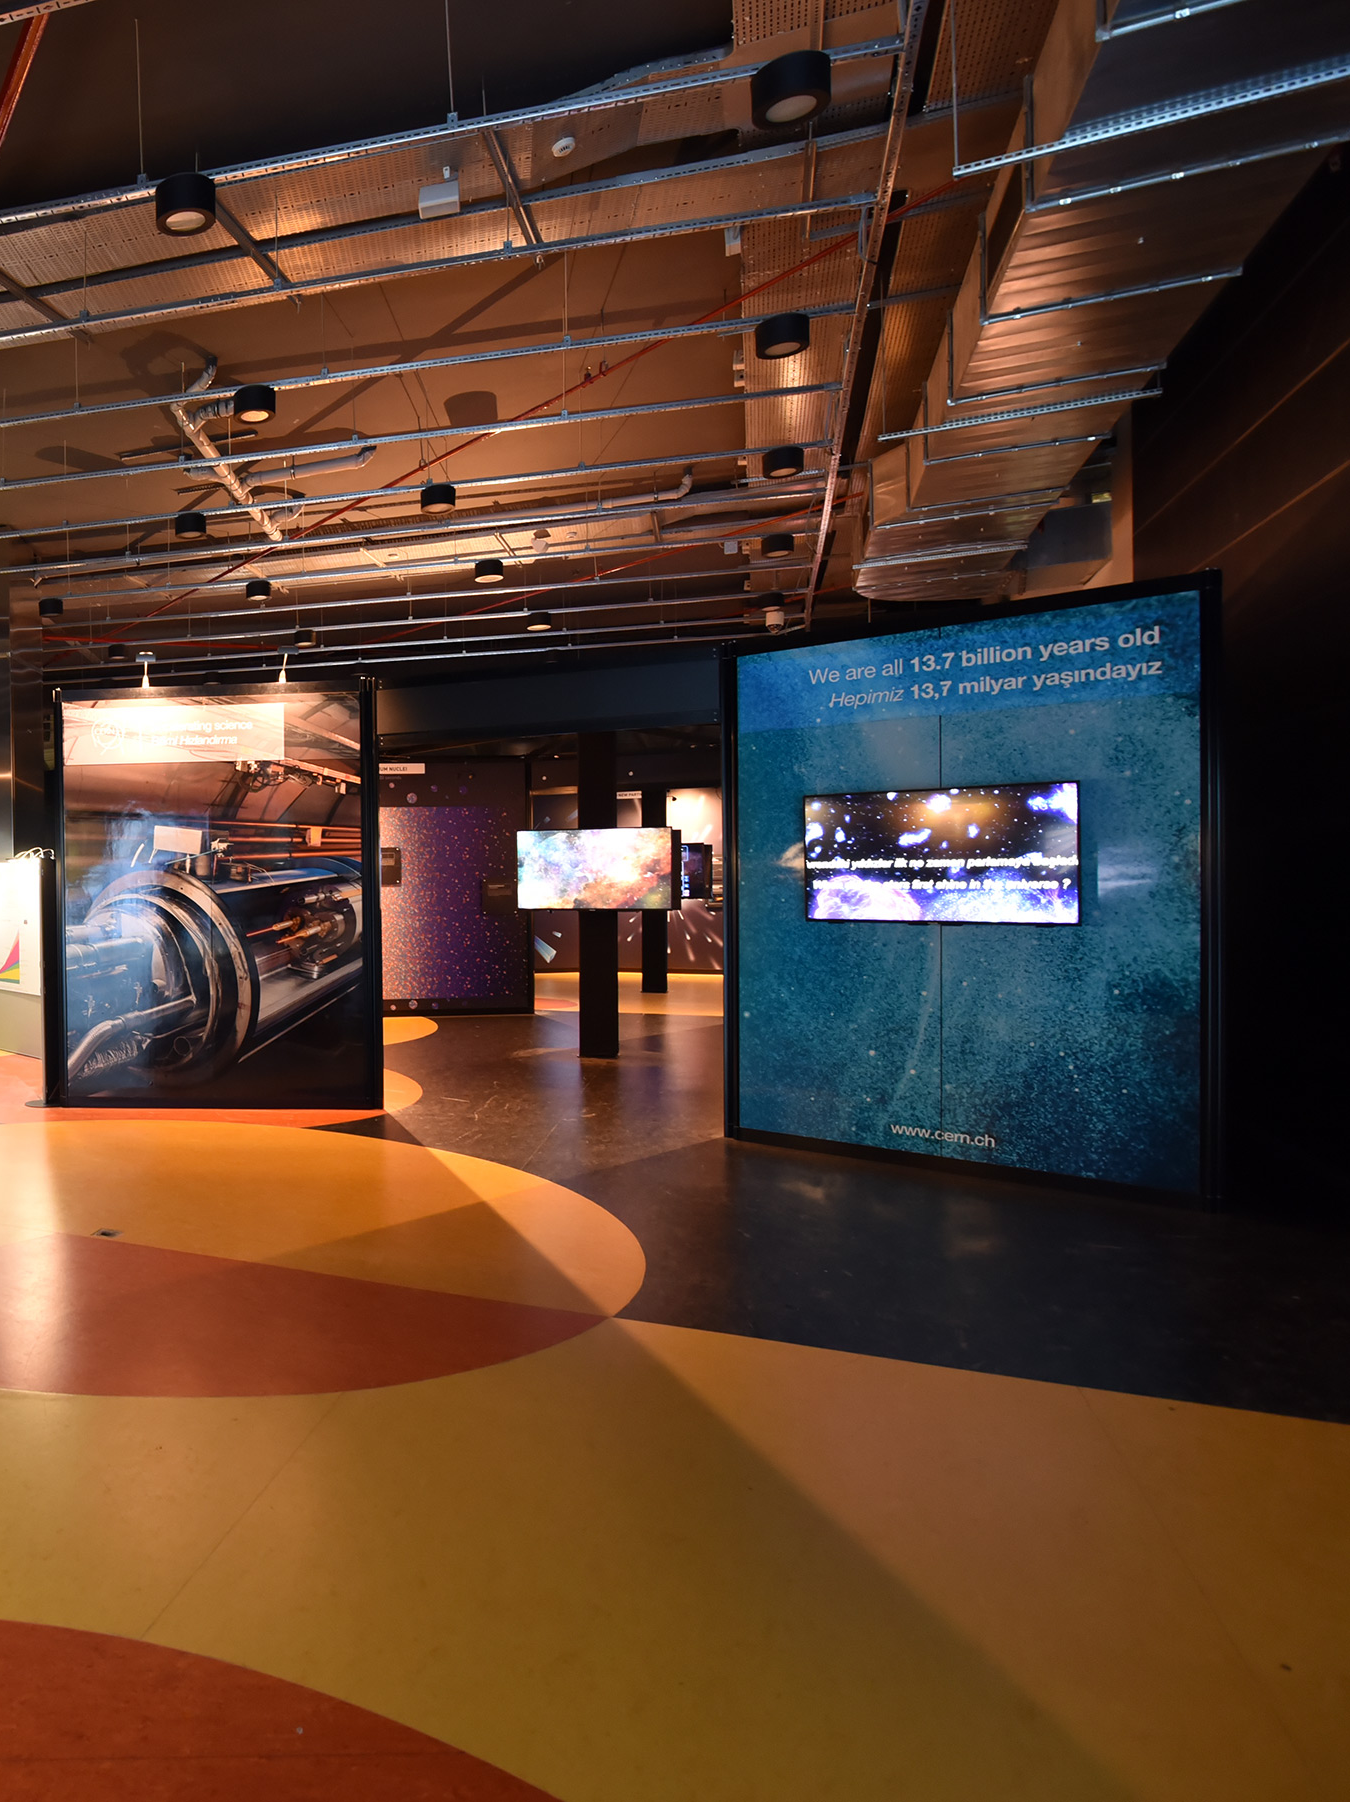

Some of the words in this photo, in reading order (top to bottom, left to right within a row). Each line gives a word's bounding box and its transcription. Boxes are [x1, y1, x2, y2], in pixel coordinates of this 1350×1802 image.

[808, 667, 840, 685] We
[845, 665, 876, 681] are
[881, 658, 903, 677] all
[910, 652, 955, 672] 13.7
[961, 646, 1032, 667] billion
[1039, 636, 1110, 662] years
[1118, 625, 1161, 648] old
[829, 687, 905, 709] Hepimiz
[910, 680, 953, 700] 13,7
[958, 675, 1027, 695] milyar
[1032, 661, 1163, 691] yaşındayız
[214, 720, 253, 731] science
[890, 1124, 996, 1148] www.cern.ch
